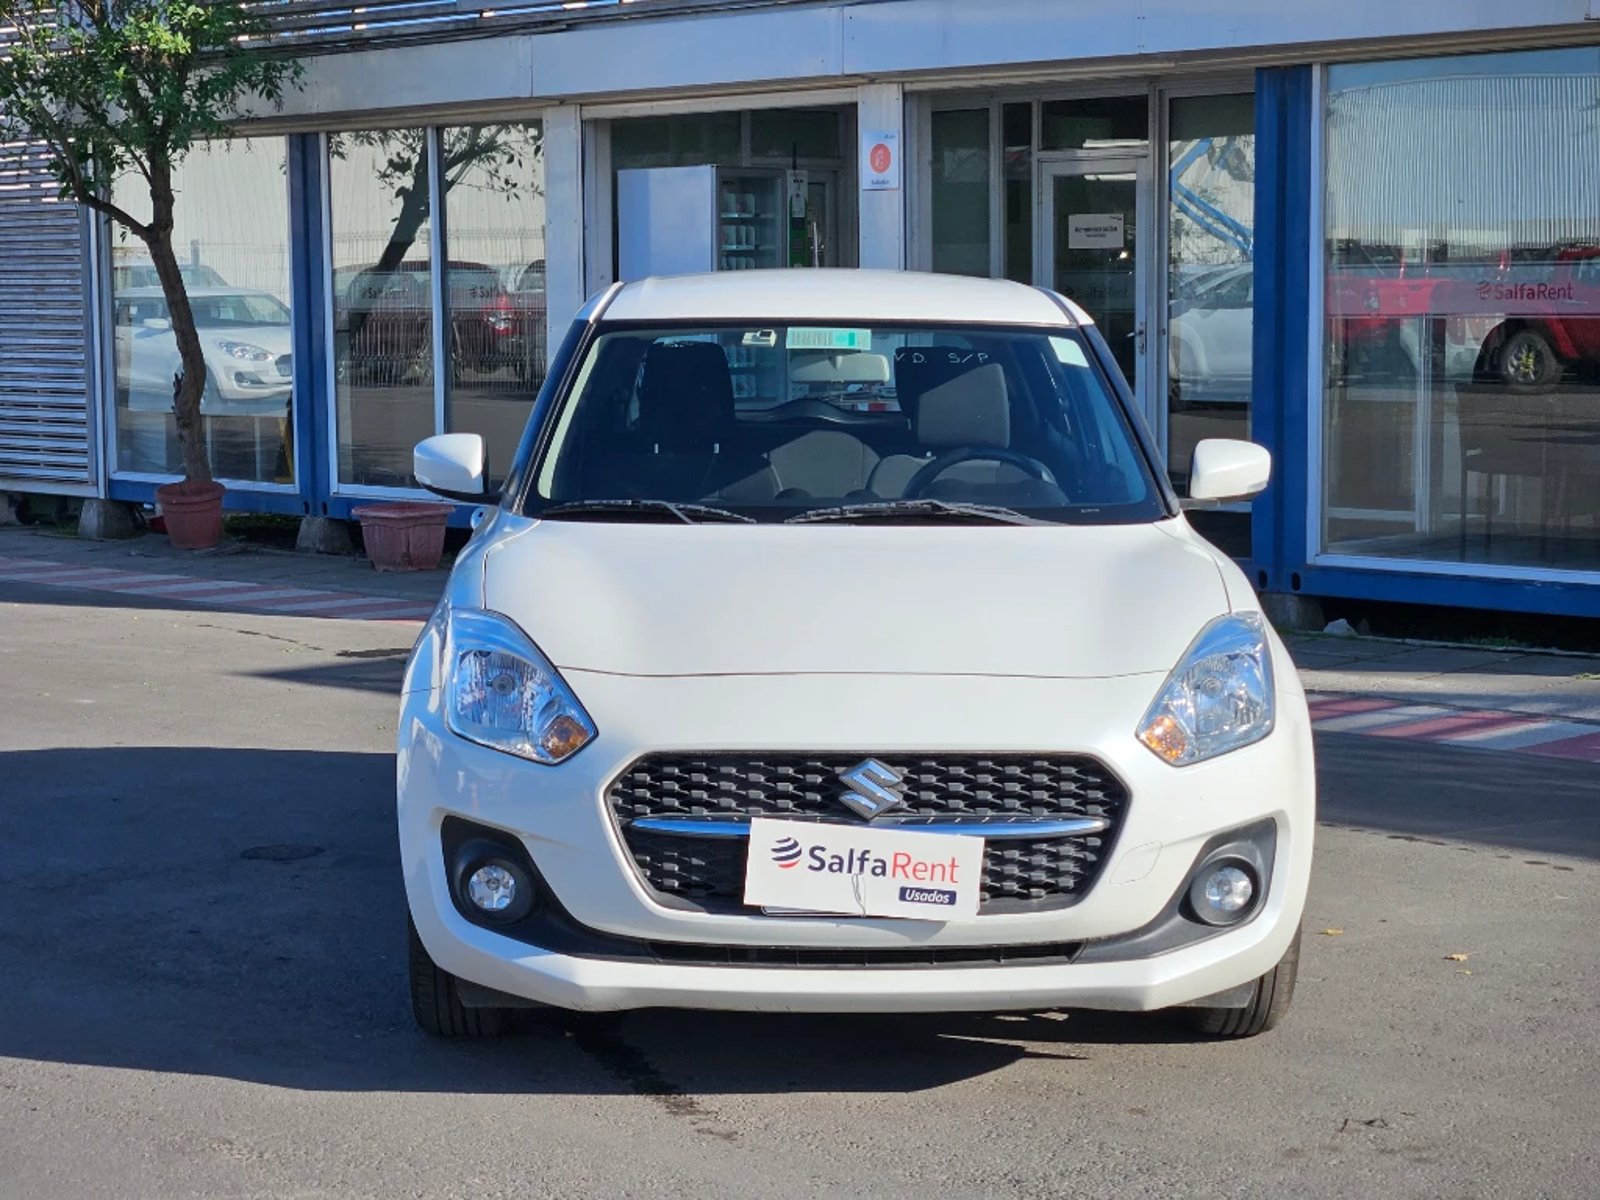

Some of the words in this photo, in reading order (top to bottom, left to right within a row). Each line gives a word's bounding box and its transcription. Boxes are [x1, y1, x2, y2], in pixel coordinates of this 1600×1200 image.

[1494, 282, 1573, 300] SalfaRent
[807, 844, 959, 883] SalfaRent
[905, 888, 950, 904] Usados
